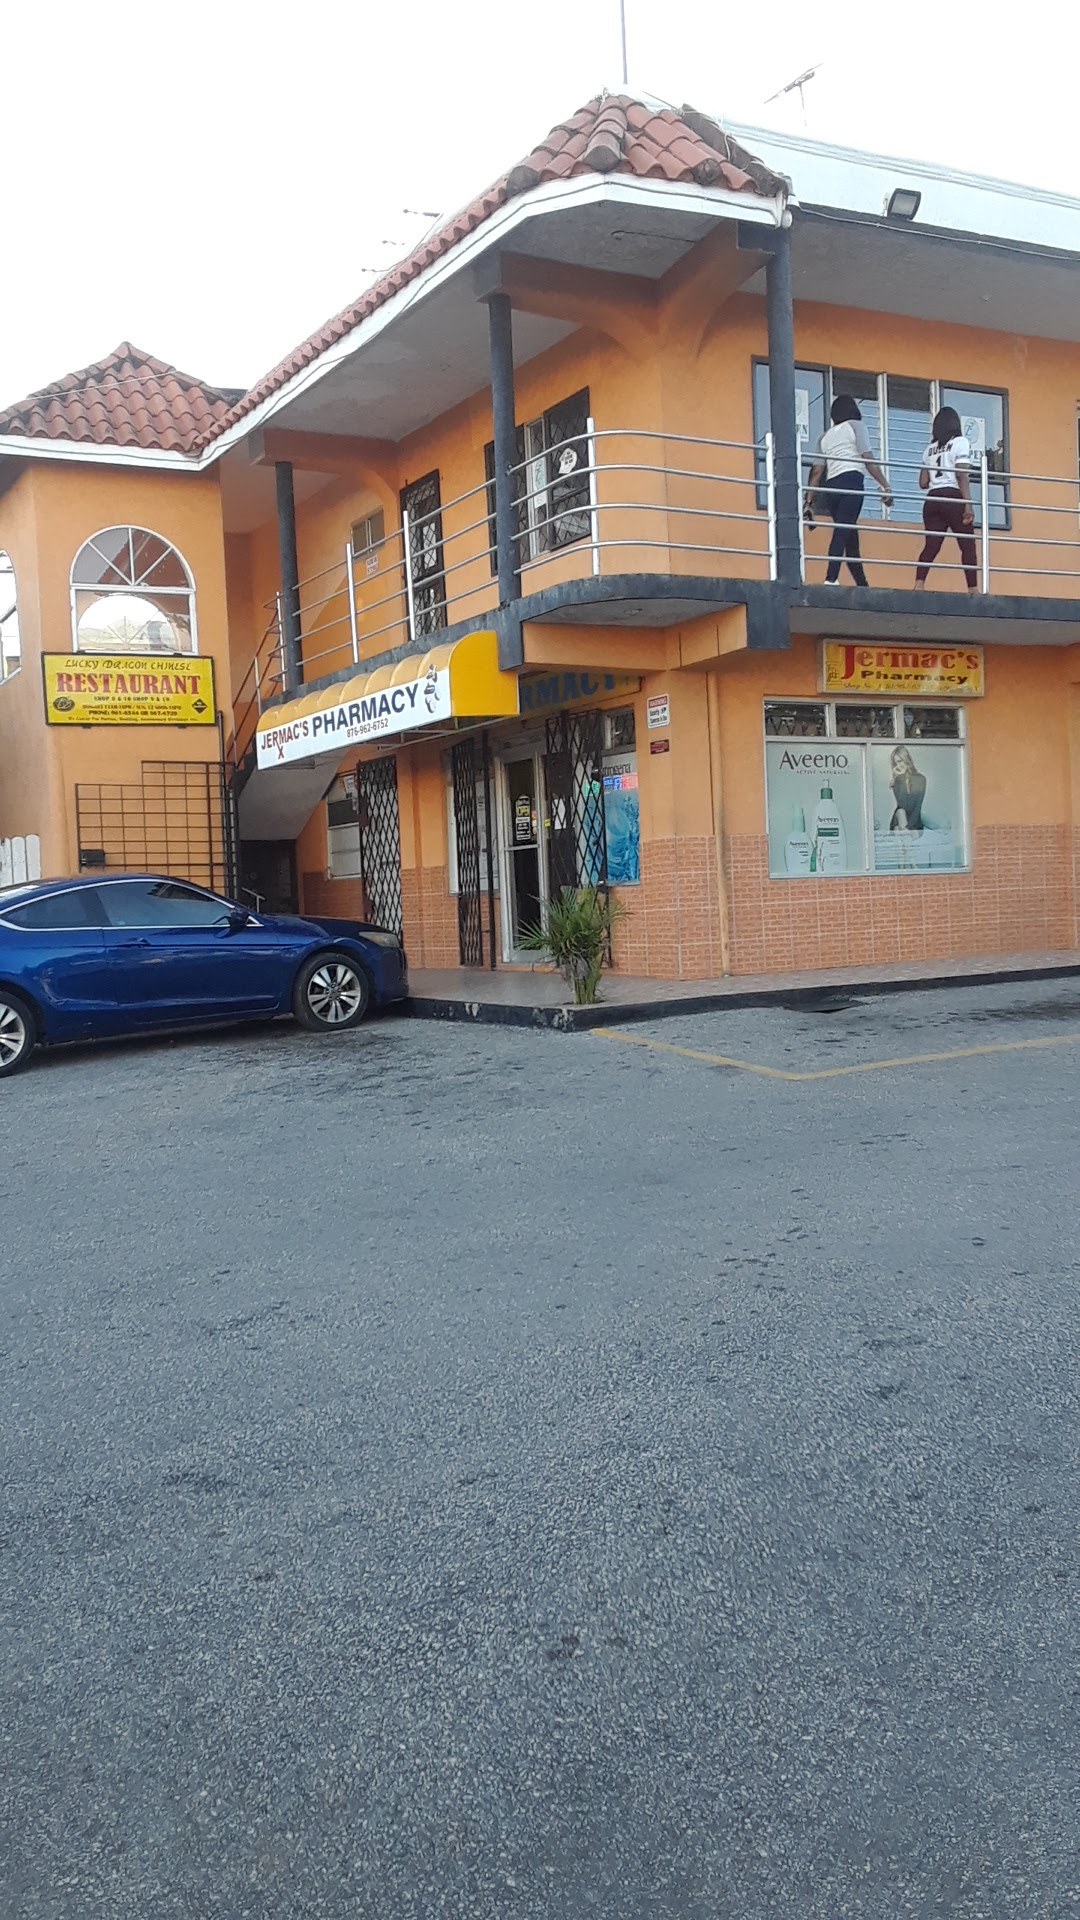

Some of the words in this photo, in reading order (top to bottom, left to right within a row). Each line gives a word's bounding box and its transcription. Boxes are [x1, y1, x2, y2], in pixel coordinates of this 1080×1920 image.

[65, 659, 99, 670] LUCKY
[102, 660, 148, 670] DRAGON
[151, 661, 191, 671] CHINESE
[839, 644, 979, 680] Jermac's
[56, 672, 201, 695] RESTAURANT
[861, 670, 969, 685] Pharmacy
[261, 720, 309, 750] JERMAC'S
[312, 683, 419, 738] PHARMACY
[346, 718, 389, 738] 876-962-6752
[779, 750, 849, 770] Aveeno
[817, 815, 840, 823] Aveeno
